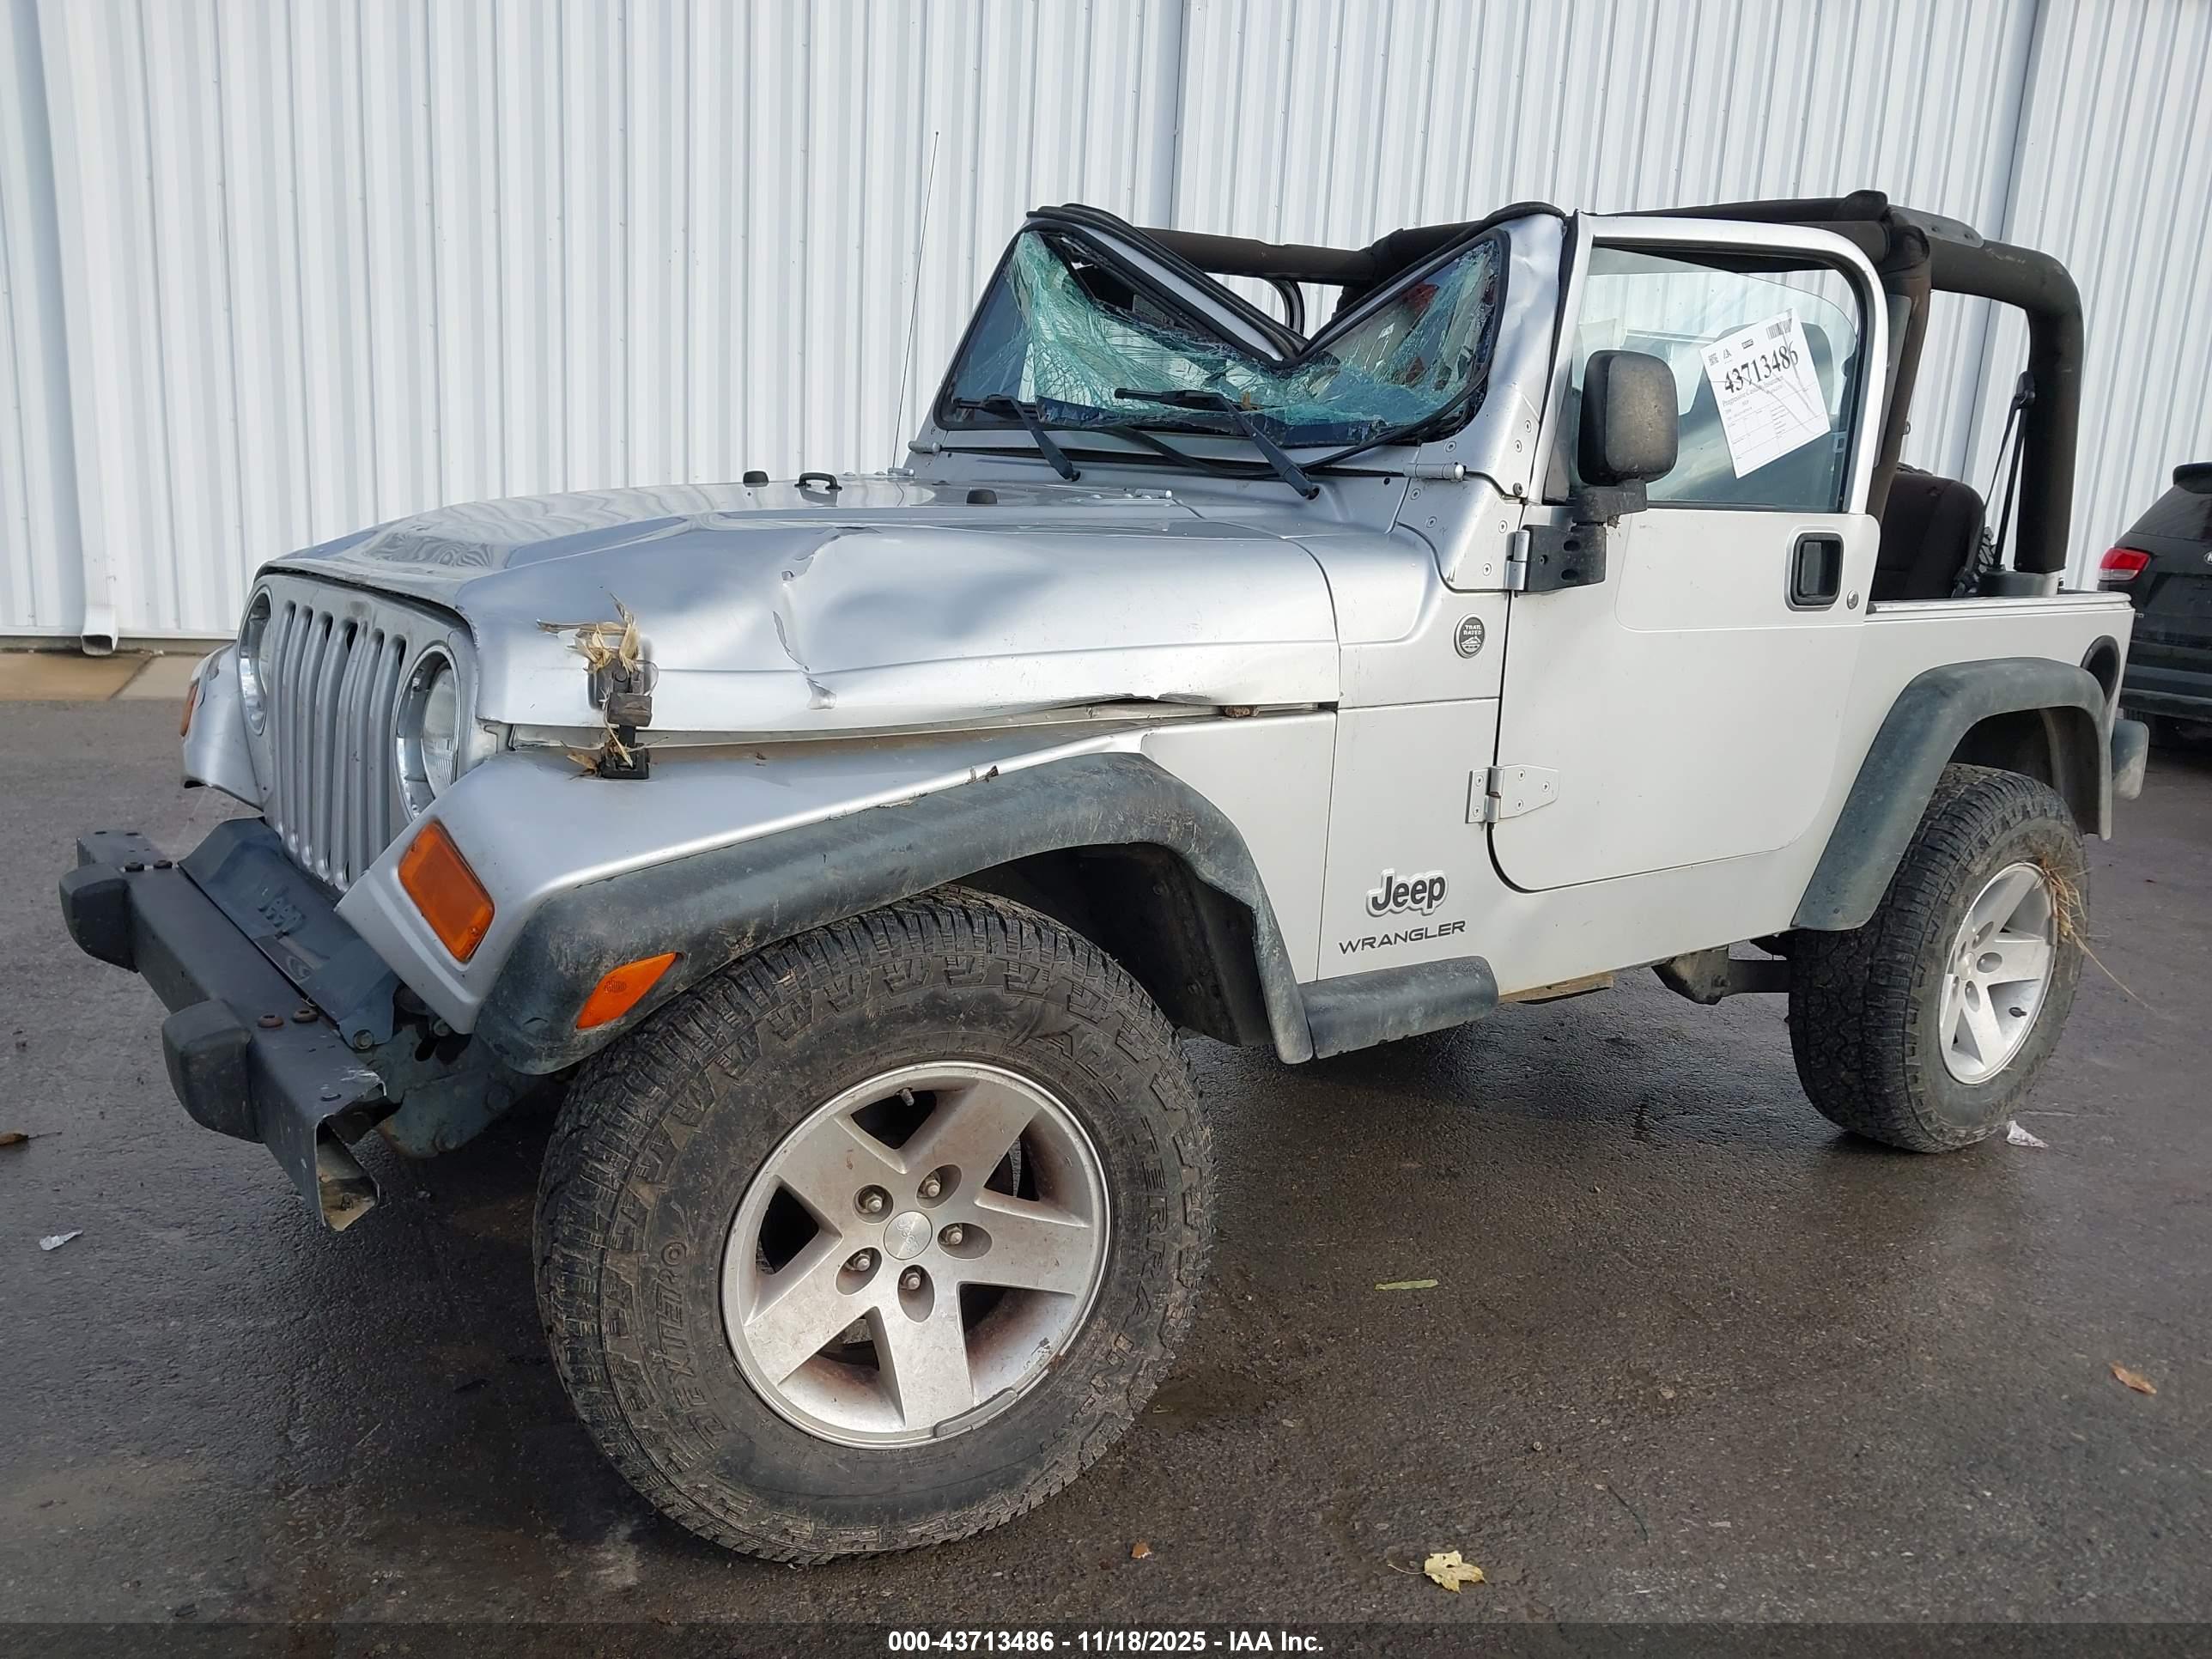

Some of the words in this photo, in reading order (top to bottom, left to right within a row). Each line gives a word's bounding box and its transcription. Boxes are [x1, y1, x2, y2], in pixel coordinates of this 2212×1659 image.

[1724, 341, 1799, 393] 43713486
[1370, 874, 1446, 911] Jeep
[1339, 920, 1467, 955] WRANGLER
